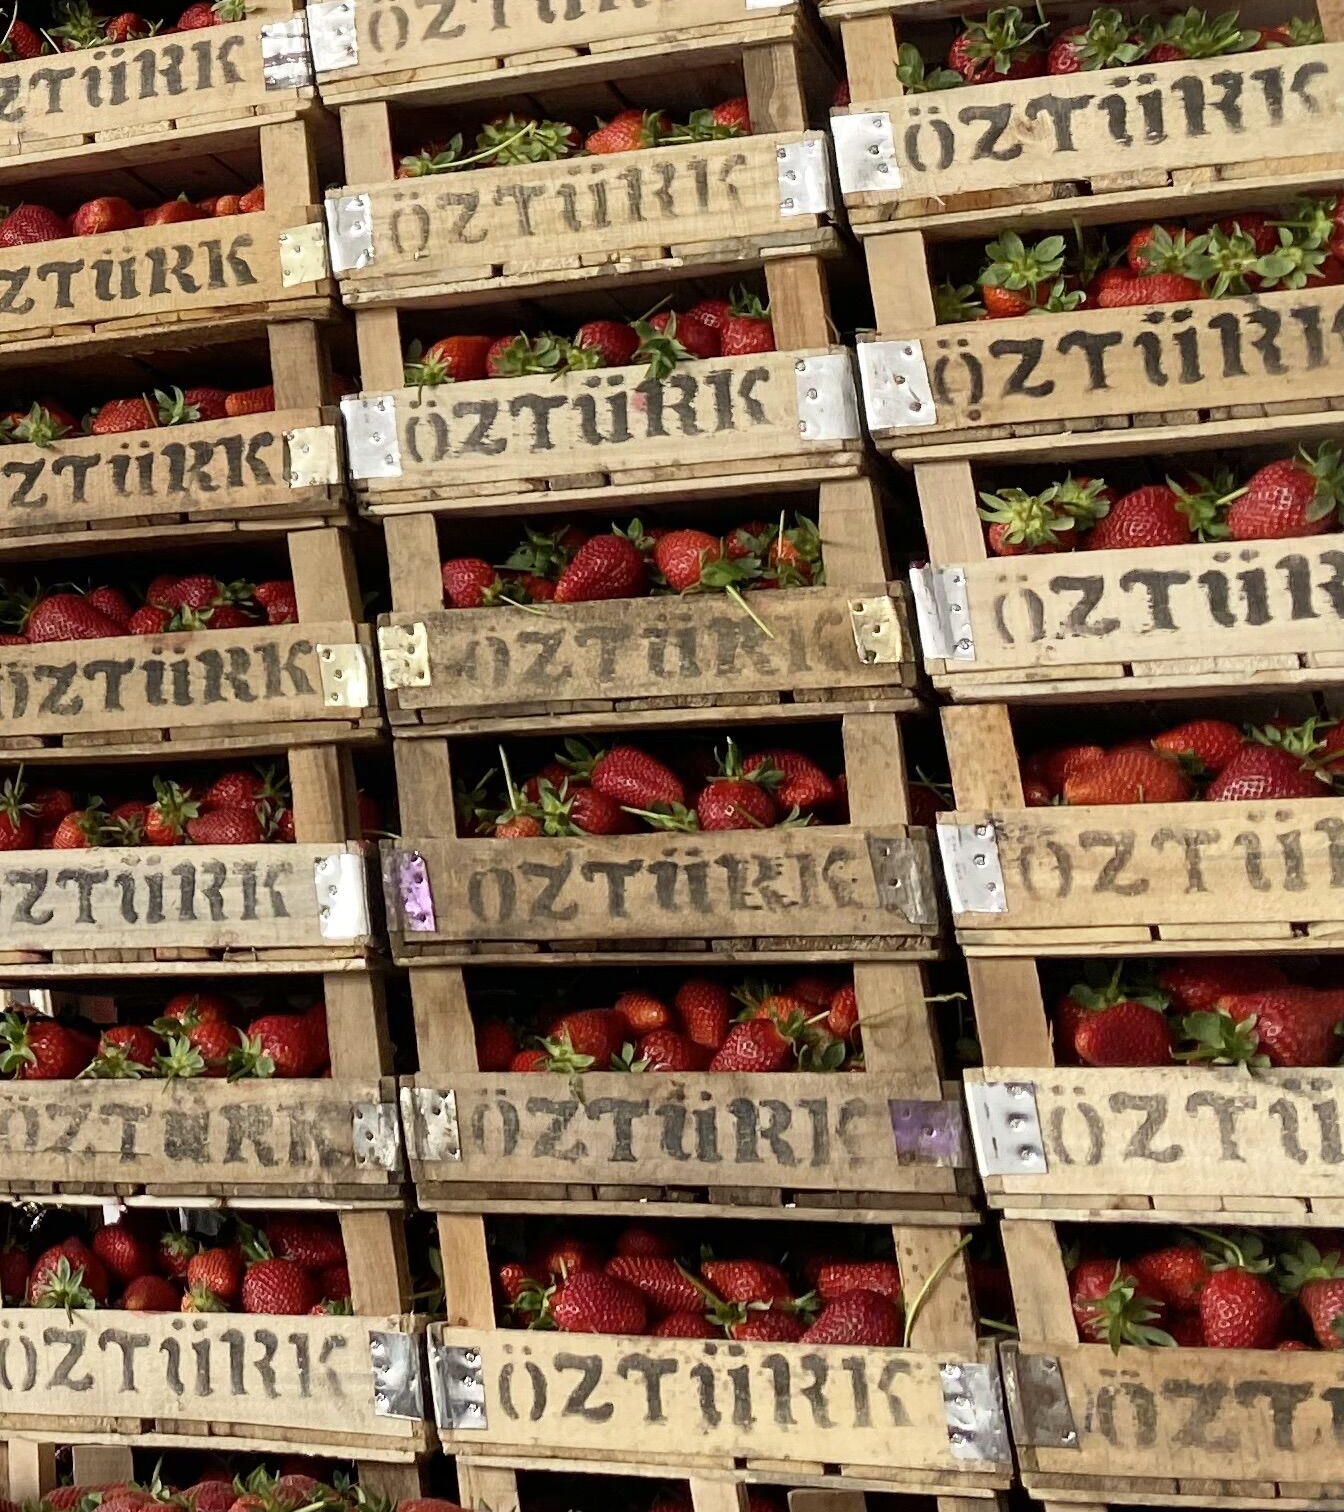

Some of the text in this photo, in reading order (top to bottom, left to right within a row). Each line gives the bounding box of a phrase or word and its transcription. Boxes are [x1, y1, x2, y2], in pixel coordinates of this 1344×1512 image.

[905, 62, 1329, 173] ÖZTÜRK
[390, 154, 746, 255] ÖZTÜRK
[405, 366, 772, 463] ÖZTÜRK
[471, 1081, 869, 1167] ÖZTÜRK
[498, 1342, 914, 1431] ÖZTÜRK
